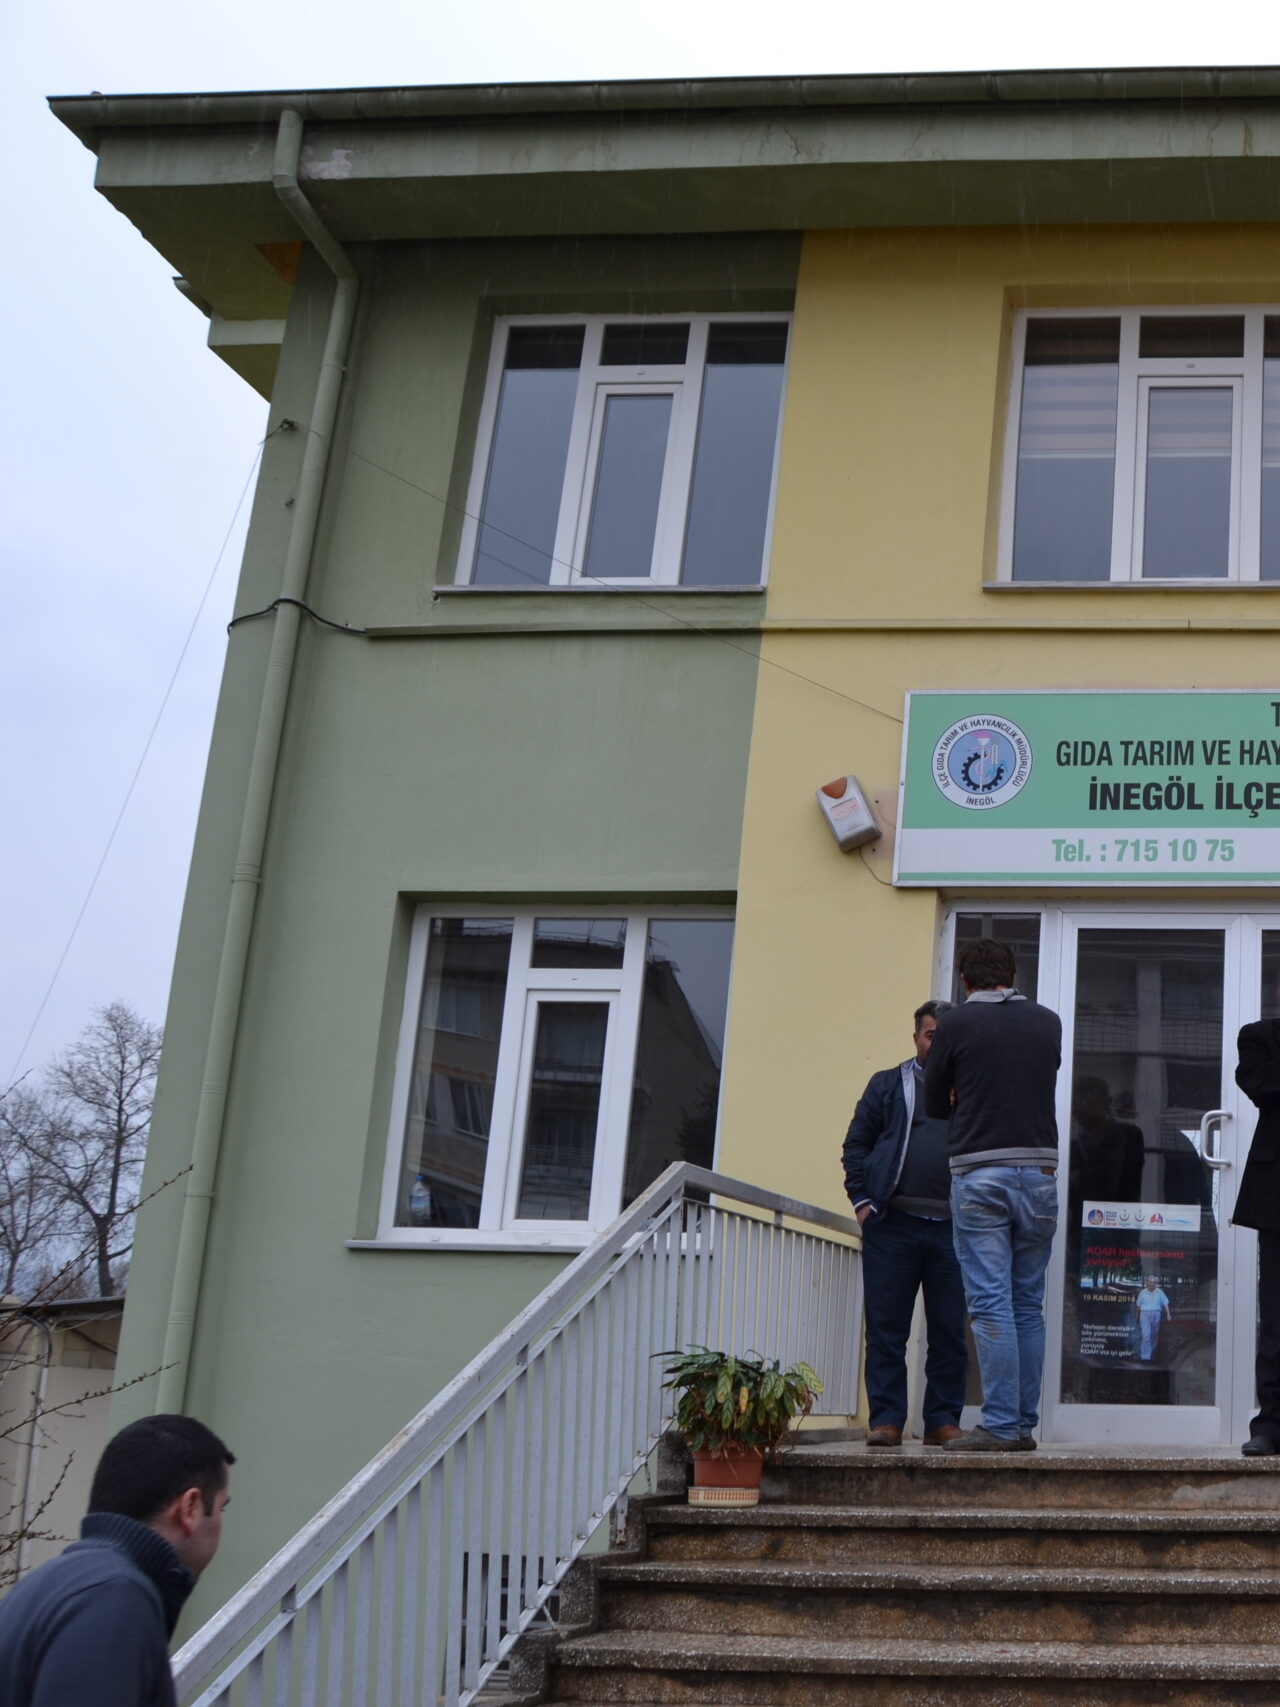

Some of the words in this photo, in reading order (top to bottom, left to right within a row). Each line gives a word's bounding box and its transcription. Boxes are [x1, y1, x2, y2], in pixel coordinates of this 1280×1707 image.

[958, 722, 969, 732] VE
[940, 729, 960, 751] TARIM
[936, 753, 946, 771] GIDA
[1056, 740, 1113, 766] GIDA
[1120, 740, 1194, 766] TARIM
[1202, 740, 1231, 765] VE
[965, 796, 996, 806] İNEGÖL
[1089, 775, 1204, 810] İNEGÖL
[1051, 839, 1091, 862] Tel.
[1114, 839, 1159, 862] 715
[1168, 839, 1197, 862] 10
[1205, 839, 1235, 862] 75
[1092, 1294, 1117, 1302] KASIM
[1118, 1295, 1136, 1303] 2014
